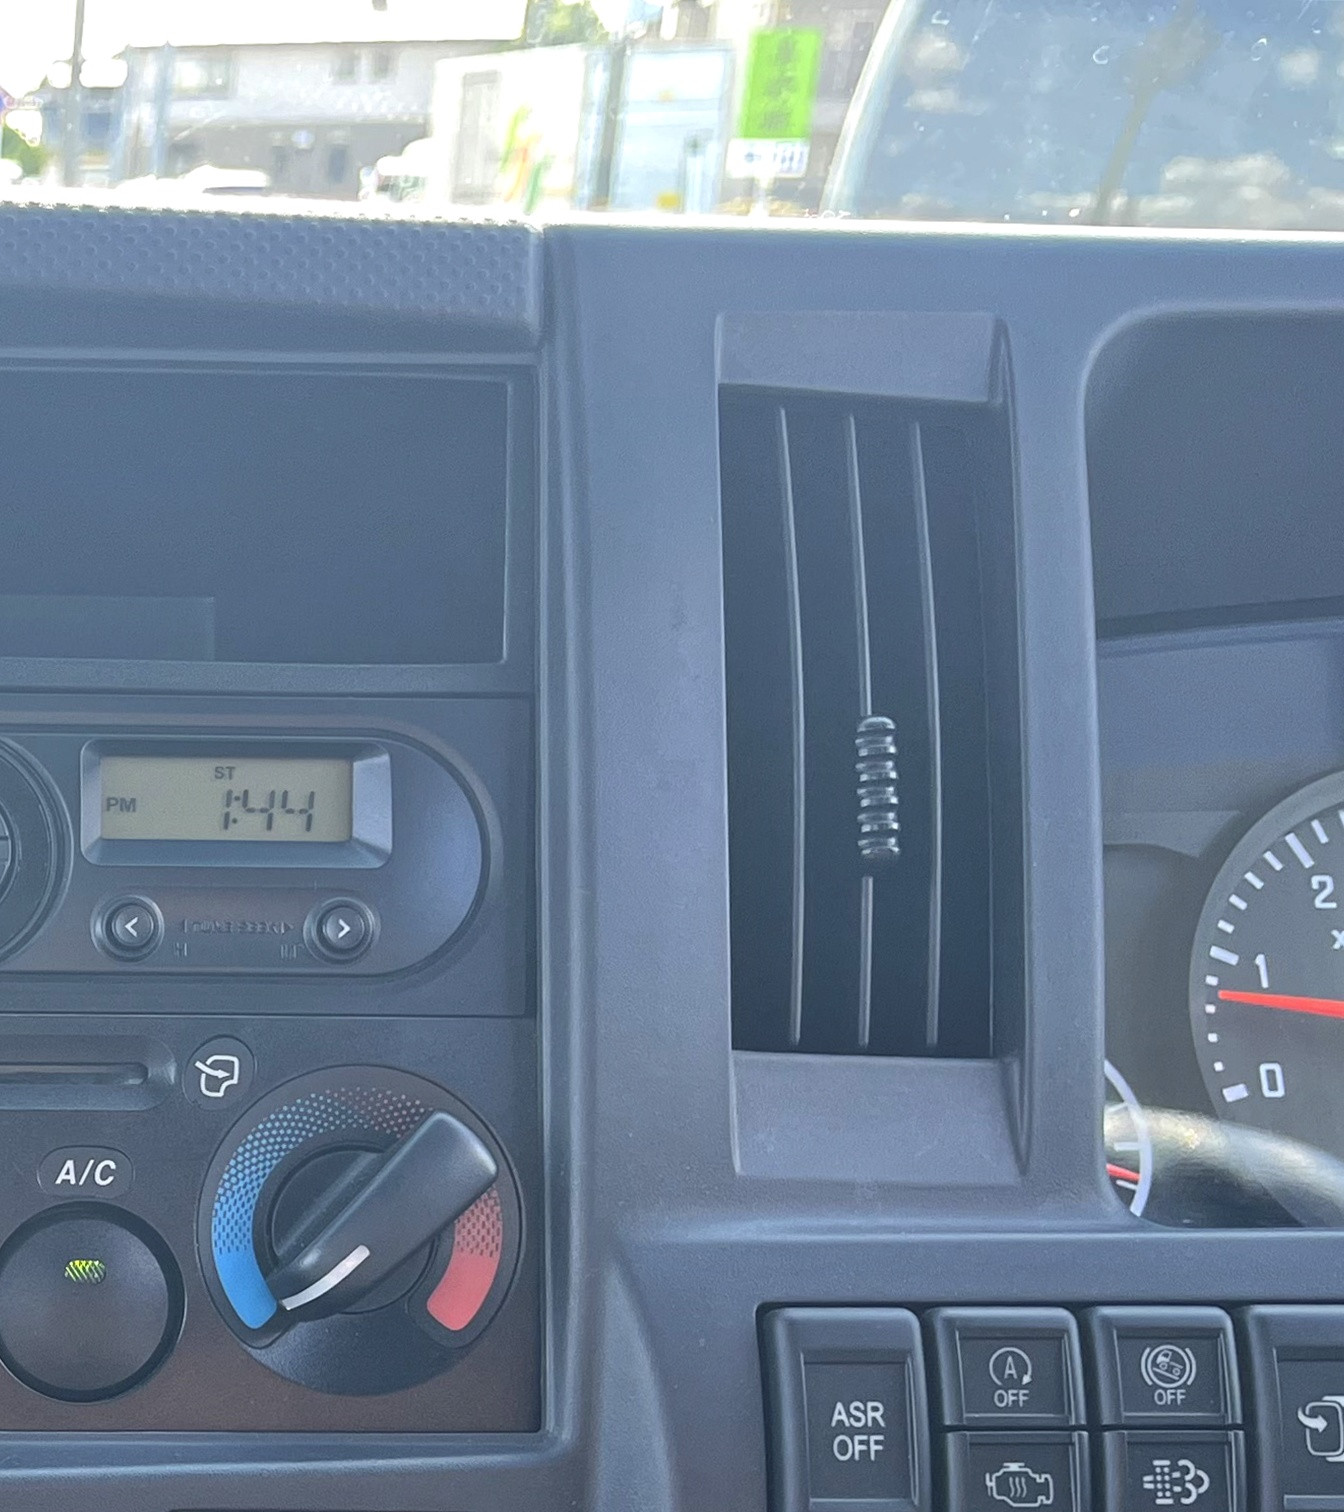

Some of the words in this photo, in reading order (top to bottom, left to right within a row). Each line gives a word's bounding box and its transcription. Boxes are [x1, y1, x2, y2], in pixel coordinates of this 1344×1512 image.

[214, 766, 236, 780] ST
[106, 796, 137, 813] PM
[223, 789, 315, 832] 1:44
[1311, 875, 1337, 909] 2
[1254, 954, 1269, 989] 1
[1259, 1062, 1285, 1098] 0
[55, 1159, 116, 1186] A/C
[994, 1389, 1029, 1407] OFF
[1153, 1388, 1186, 1405] OFF
[830, 1401, 885, 1428] ASR
[832, 1434, 884, 1461] OFF
